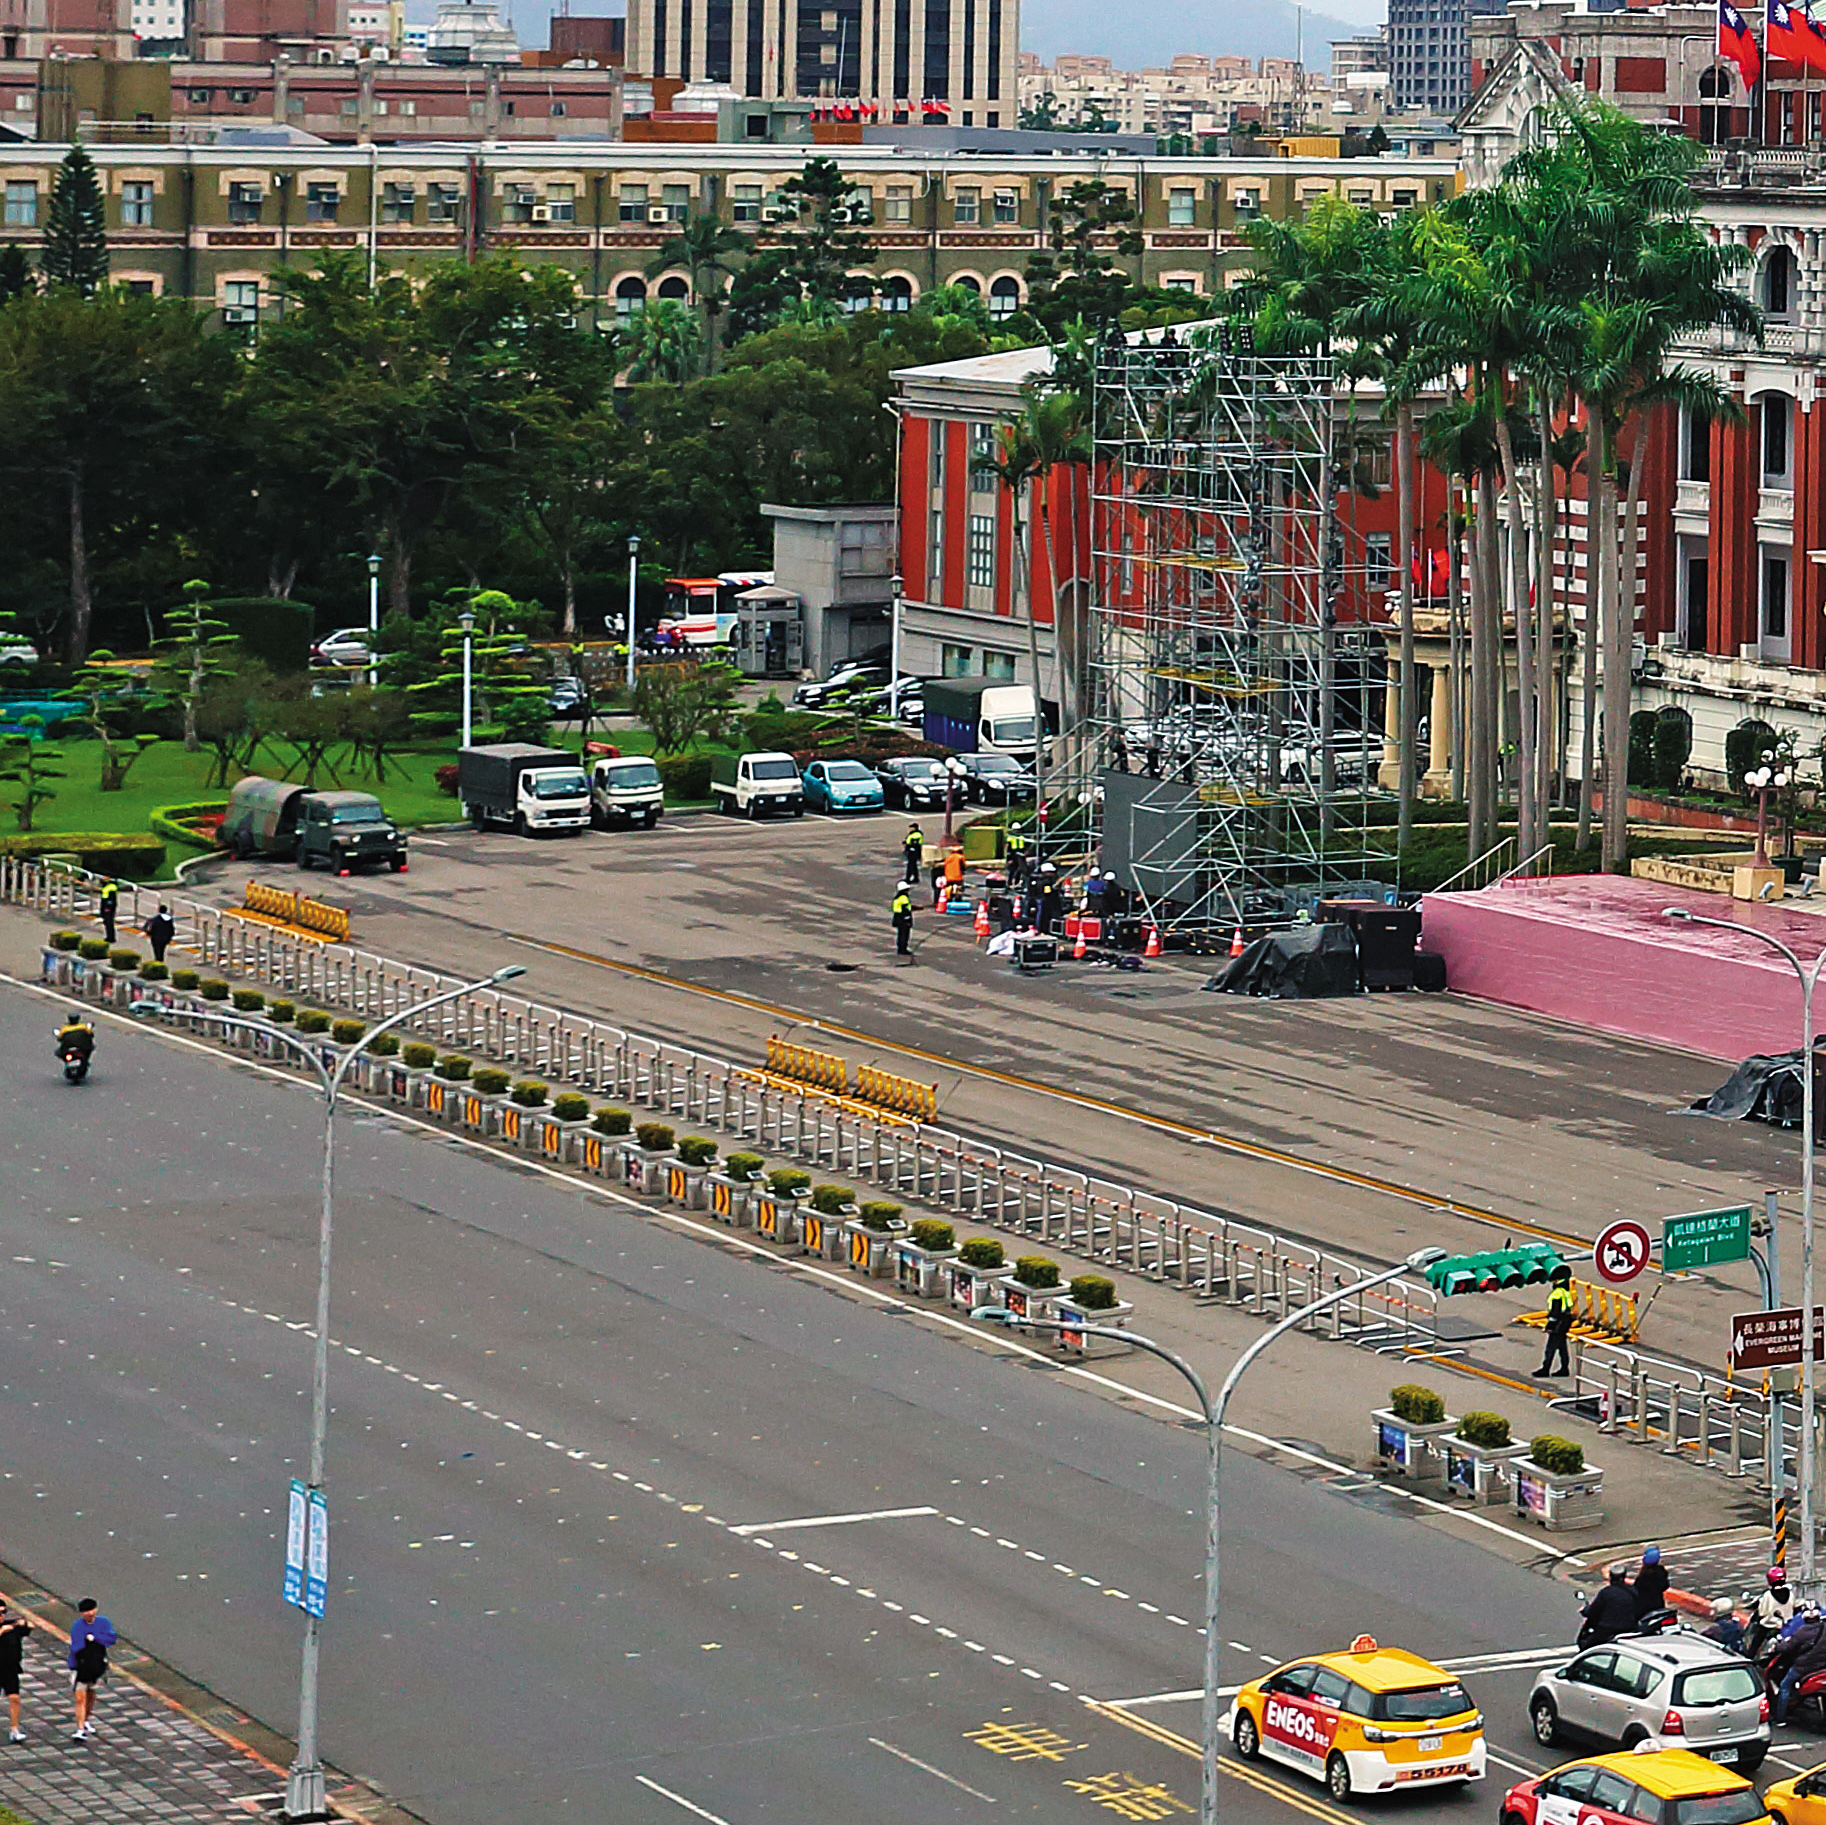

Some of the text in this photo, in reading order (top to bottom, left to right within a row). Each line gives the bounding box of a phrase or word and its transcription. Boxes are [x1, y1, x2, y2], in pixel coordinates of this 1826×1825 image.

[1743, 1316, 1824, 1335] 長榮海事博館
[1745, 1335, 1788, 1347] EVERGREEN
[1767, 1343, 1800, 1354] MUSEUM
[1266, 1700, 1316, 1741] ENEOS
[1411, 1763, 1467, 1779] 55178
